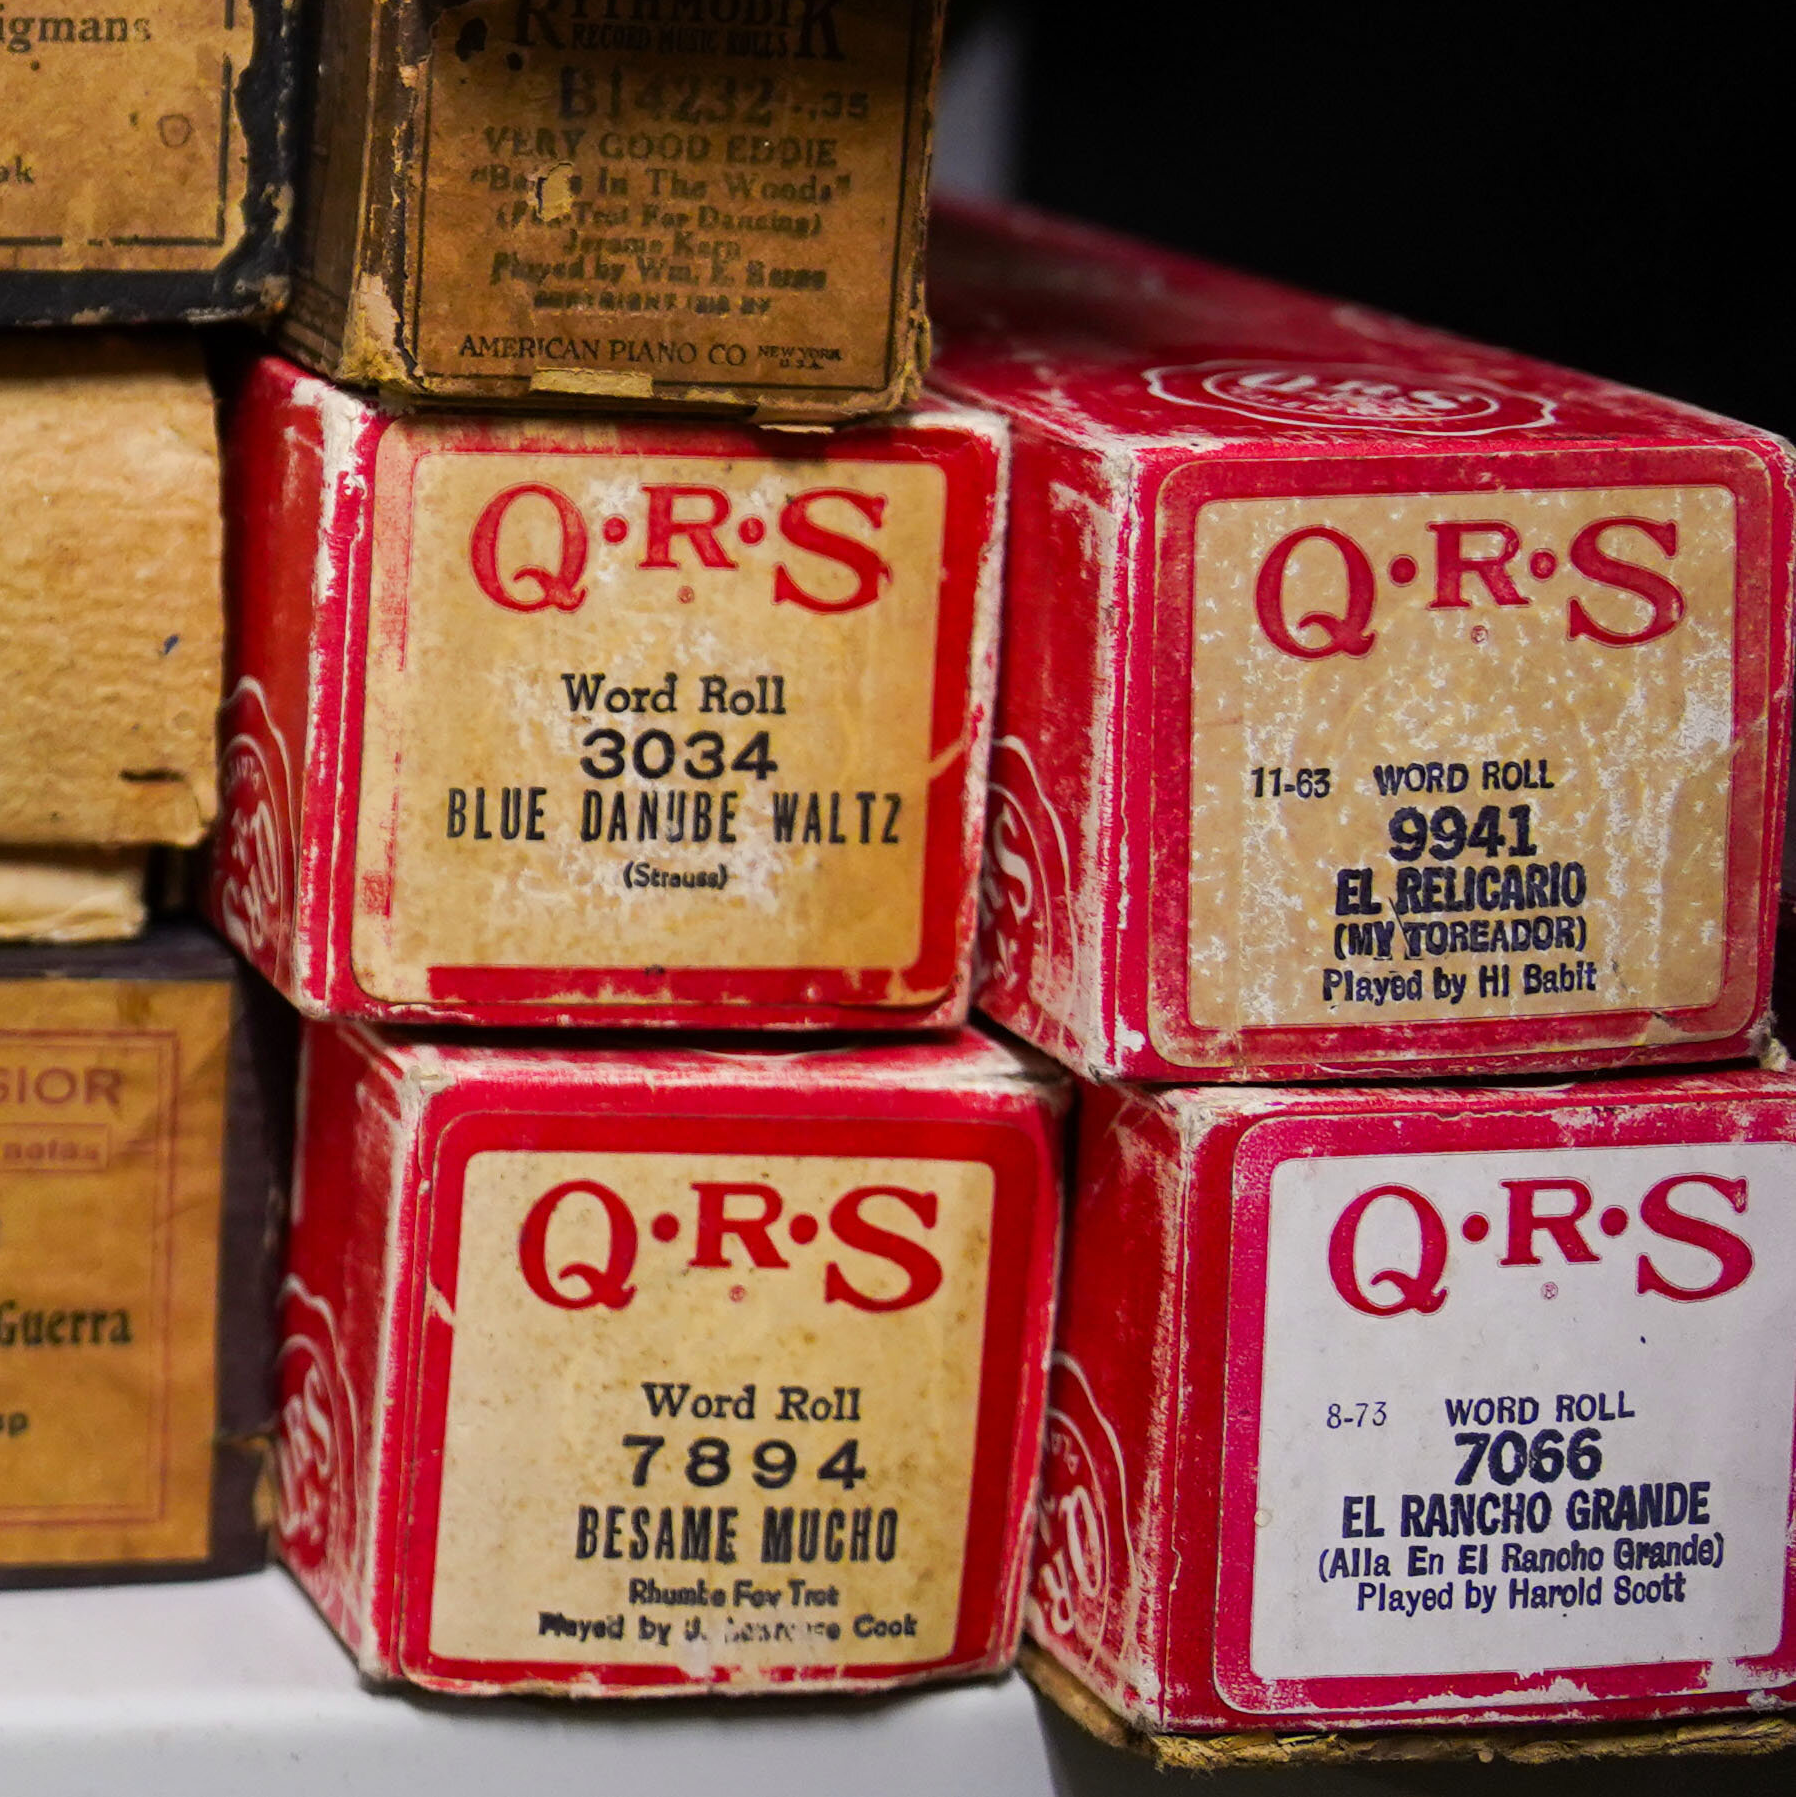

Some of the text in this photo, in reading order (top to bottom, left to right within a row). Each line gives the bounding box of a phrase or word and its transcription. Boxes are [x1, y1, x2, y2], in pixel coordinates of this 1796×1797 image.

[484, 127, 837, 167] VERY GOOD EDDIE
[460, 335, 746, 365] AMERICAN PIANO CO
[561, 673, 785, 714] Word Roll
[580, 730, 777, 780] 3034
[1251, 768, 1331, 798] 11-63
[1374, 760, 1553, 796] WORD ROLL
[446, 787, 902, 843] BLUE DANUBE WALTZ
[1388, 805, 1537, 860] 9941
[1335, 864, 1587, 915] EL RELICARIO
[642, 1383, 861, 1422] Word Roll
[1326, 1401, 1387, 1430] 8-73
[1445, 1392, 1635, 1427] WORD ROLL
[621, 1436, 866, 1491] 7894
[1455, 1428, 1602, 1486] 7066
[1343, 1482, 1710, 1539] EL RANCHO GRANDE
[576, 1505, 897, 1563] BESAME MUCHO
[1357, 1574, 1685, 1616] Played by Harold Scott
